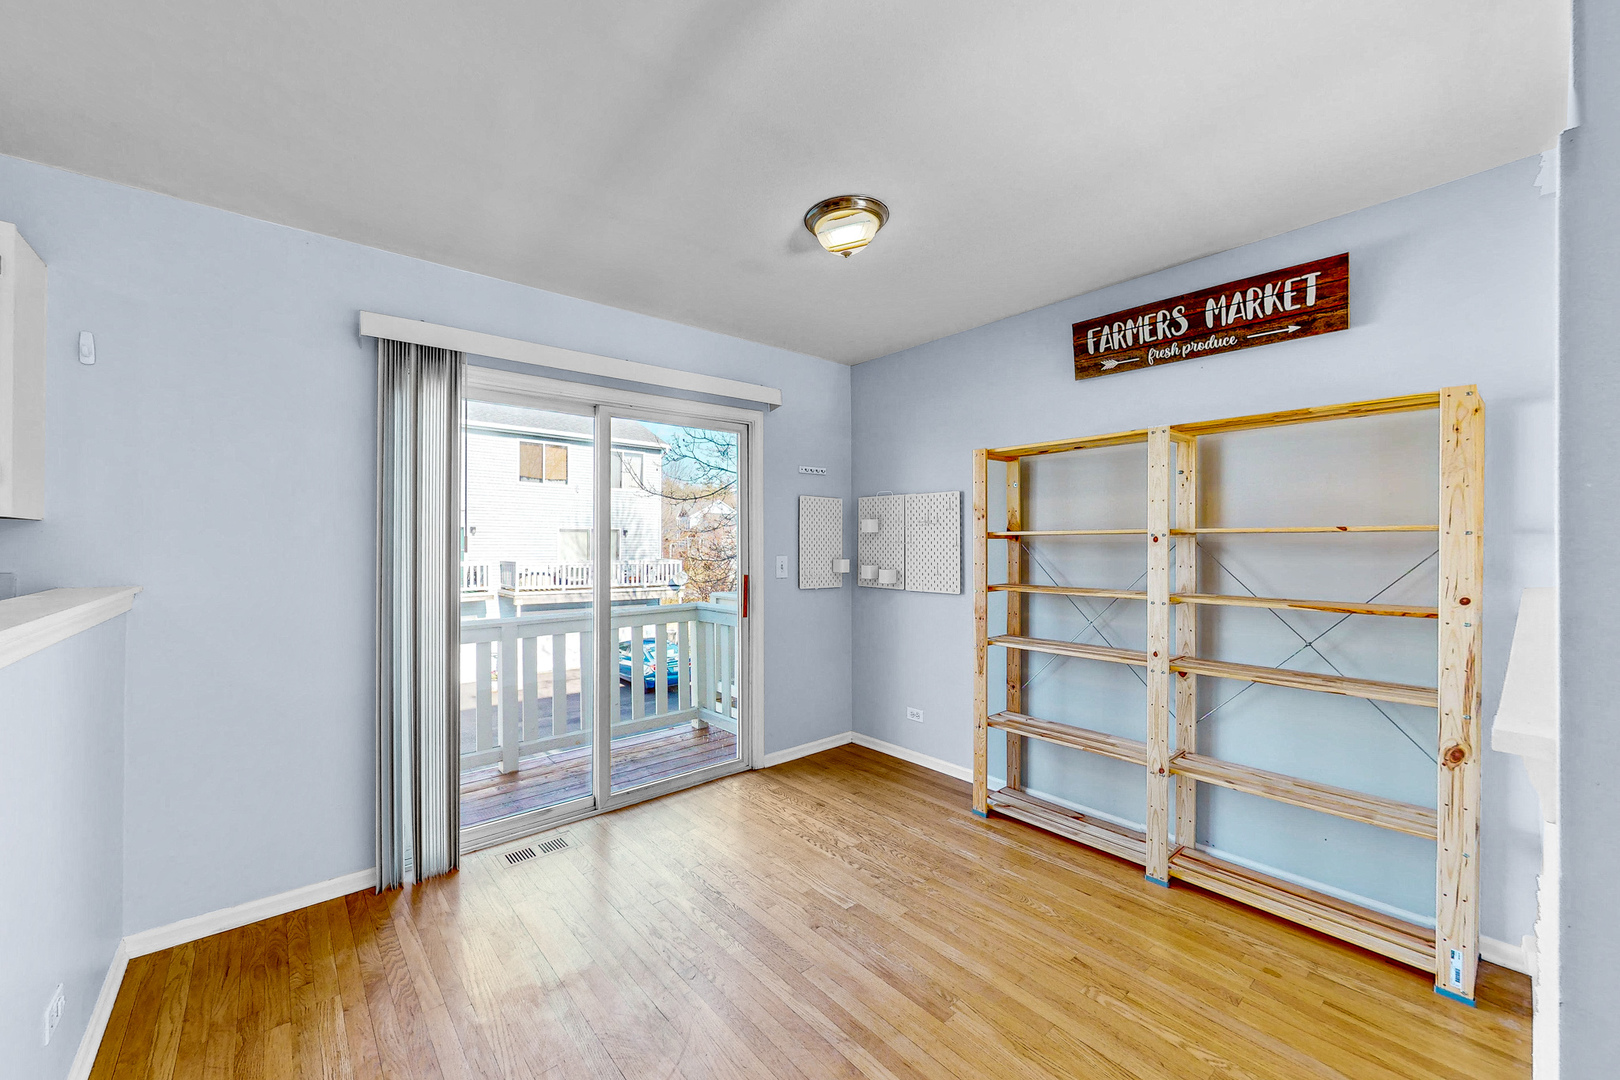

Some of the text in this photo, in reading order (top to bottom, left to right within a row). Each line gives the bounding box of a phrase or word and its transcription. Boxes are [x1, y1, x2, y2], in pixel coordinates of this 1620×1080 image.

[1087, 271, 1322, 355] FARMERS MARKET
[1147, 334, 1238, 365] fresh produce
